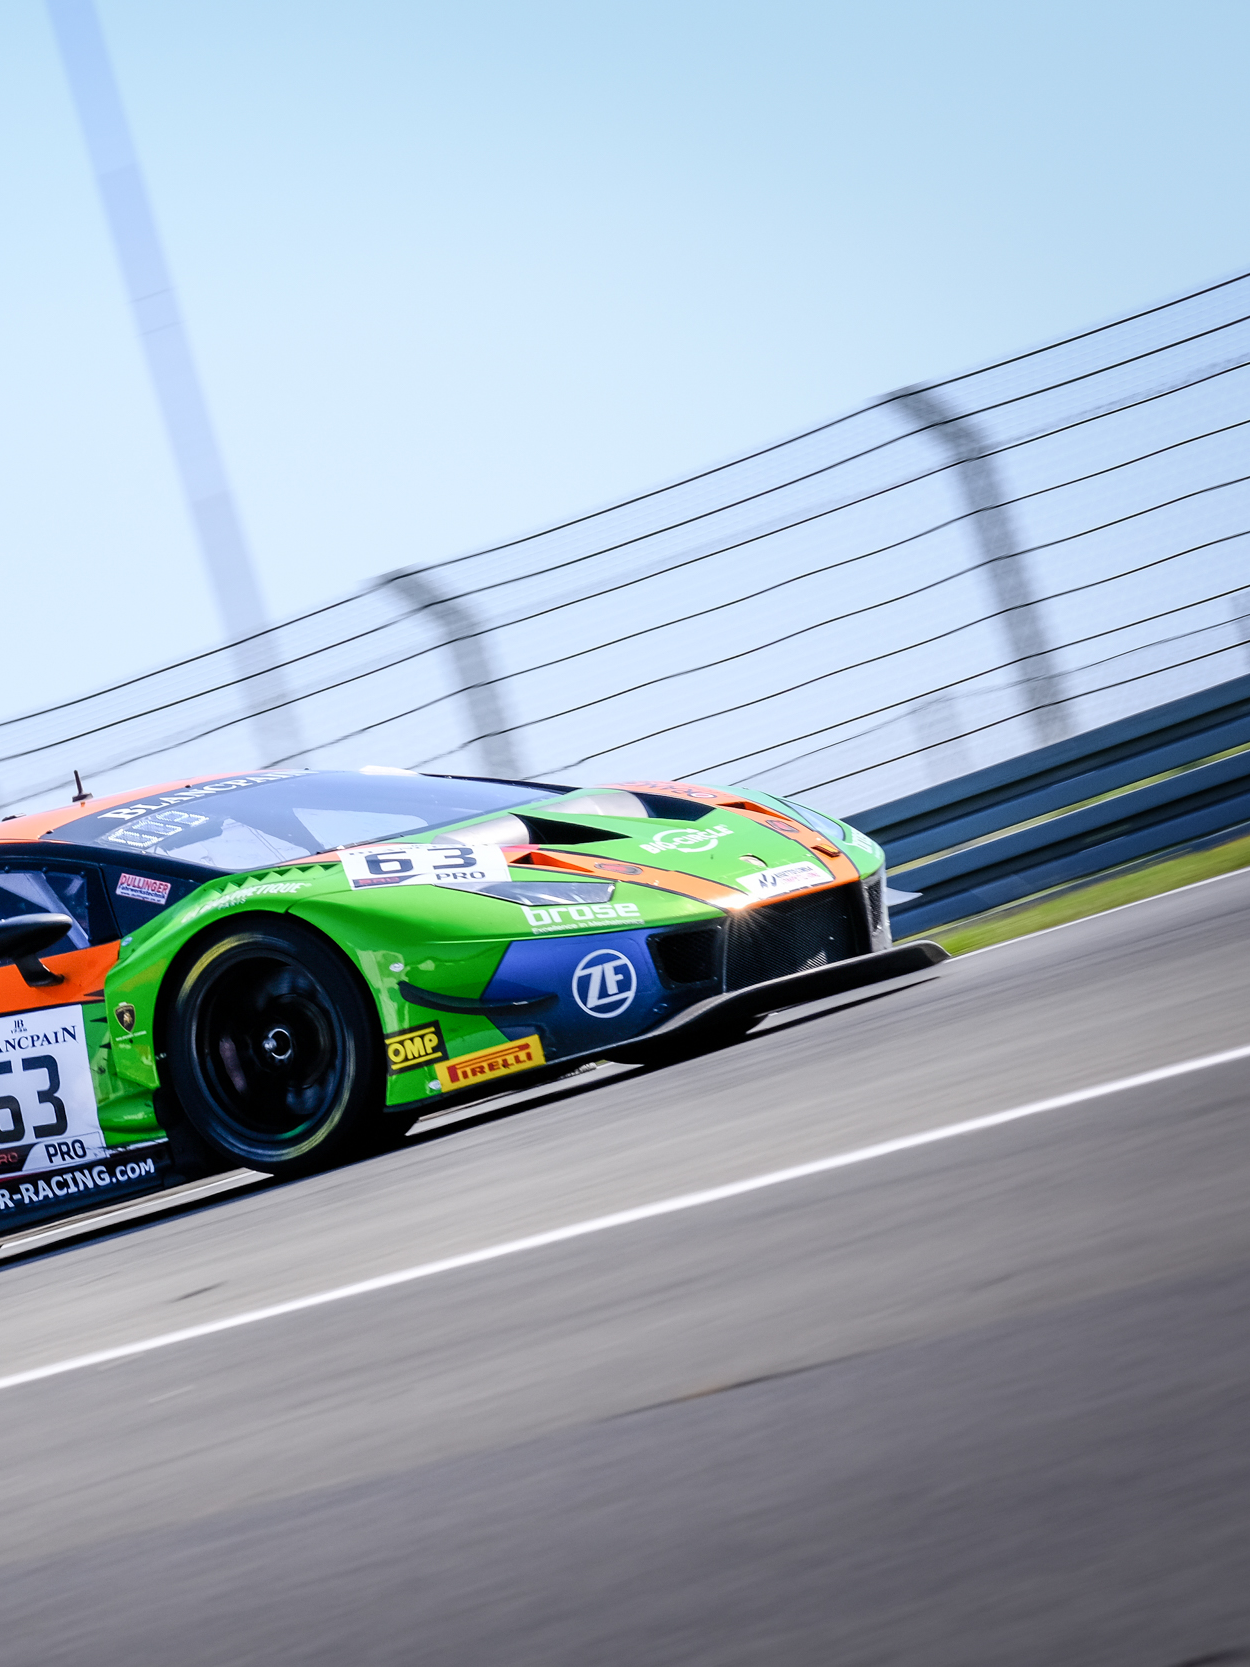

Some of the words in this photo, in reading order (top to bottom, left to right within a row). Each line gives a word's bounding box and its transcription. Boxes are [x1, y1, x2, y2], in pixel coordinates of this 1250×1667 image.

[364, 847, 477, 876] 63
[435, 870, 486, 881] PRO
[521, 902, 641, 927] brose
[576, 957, 633, 1010] ZF
[387, 1032, 439, 1063] OMP
[446, 1042, 534, 1084] PIRELLI
[44, 1138, 88, 1164] PRO
